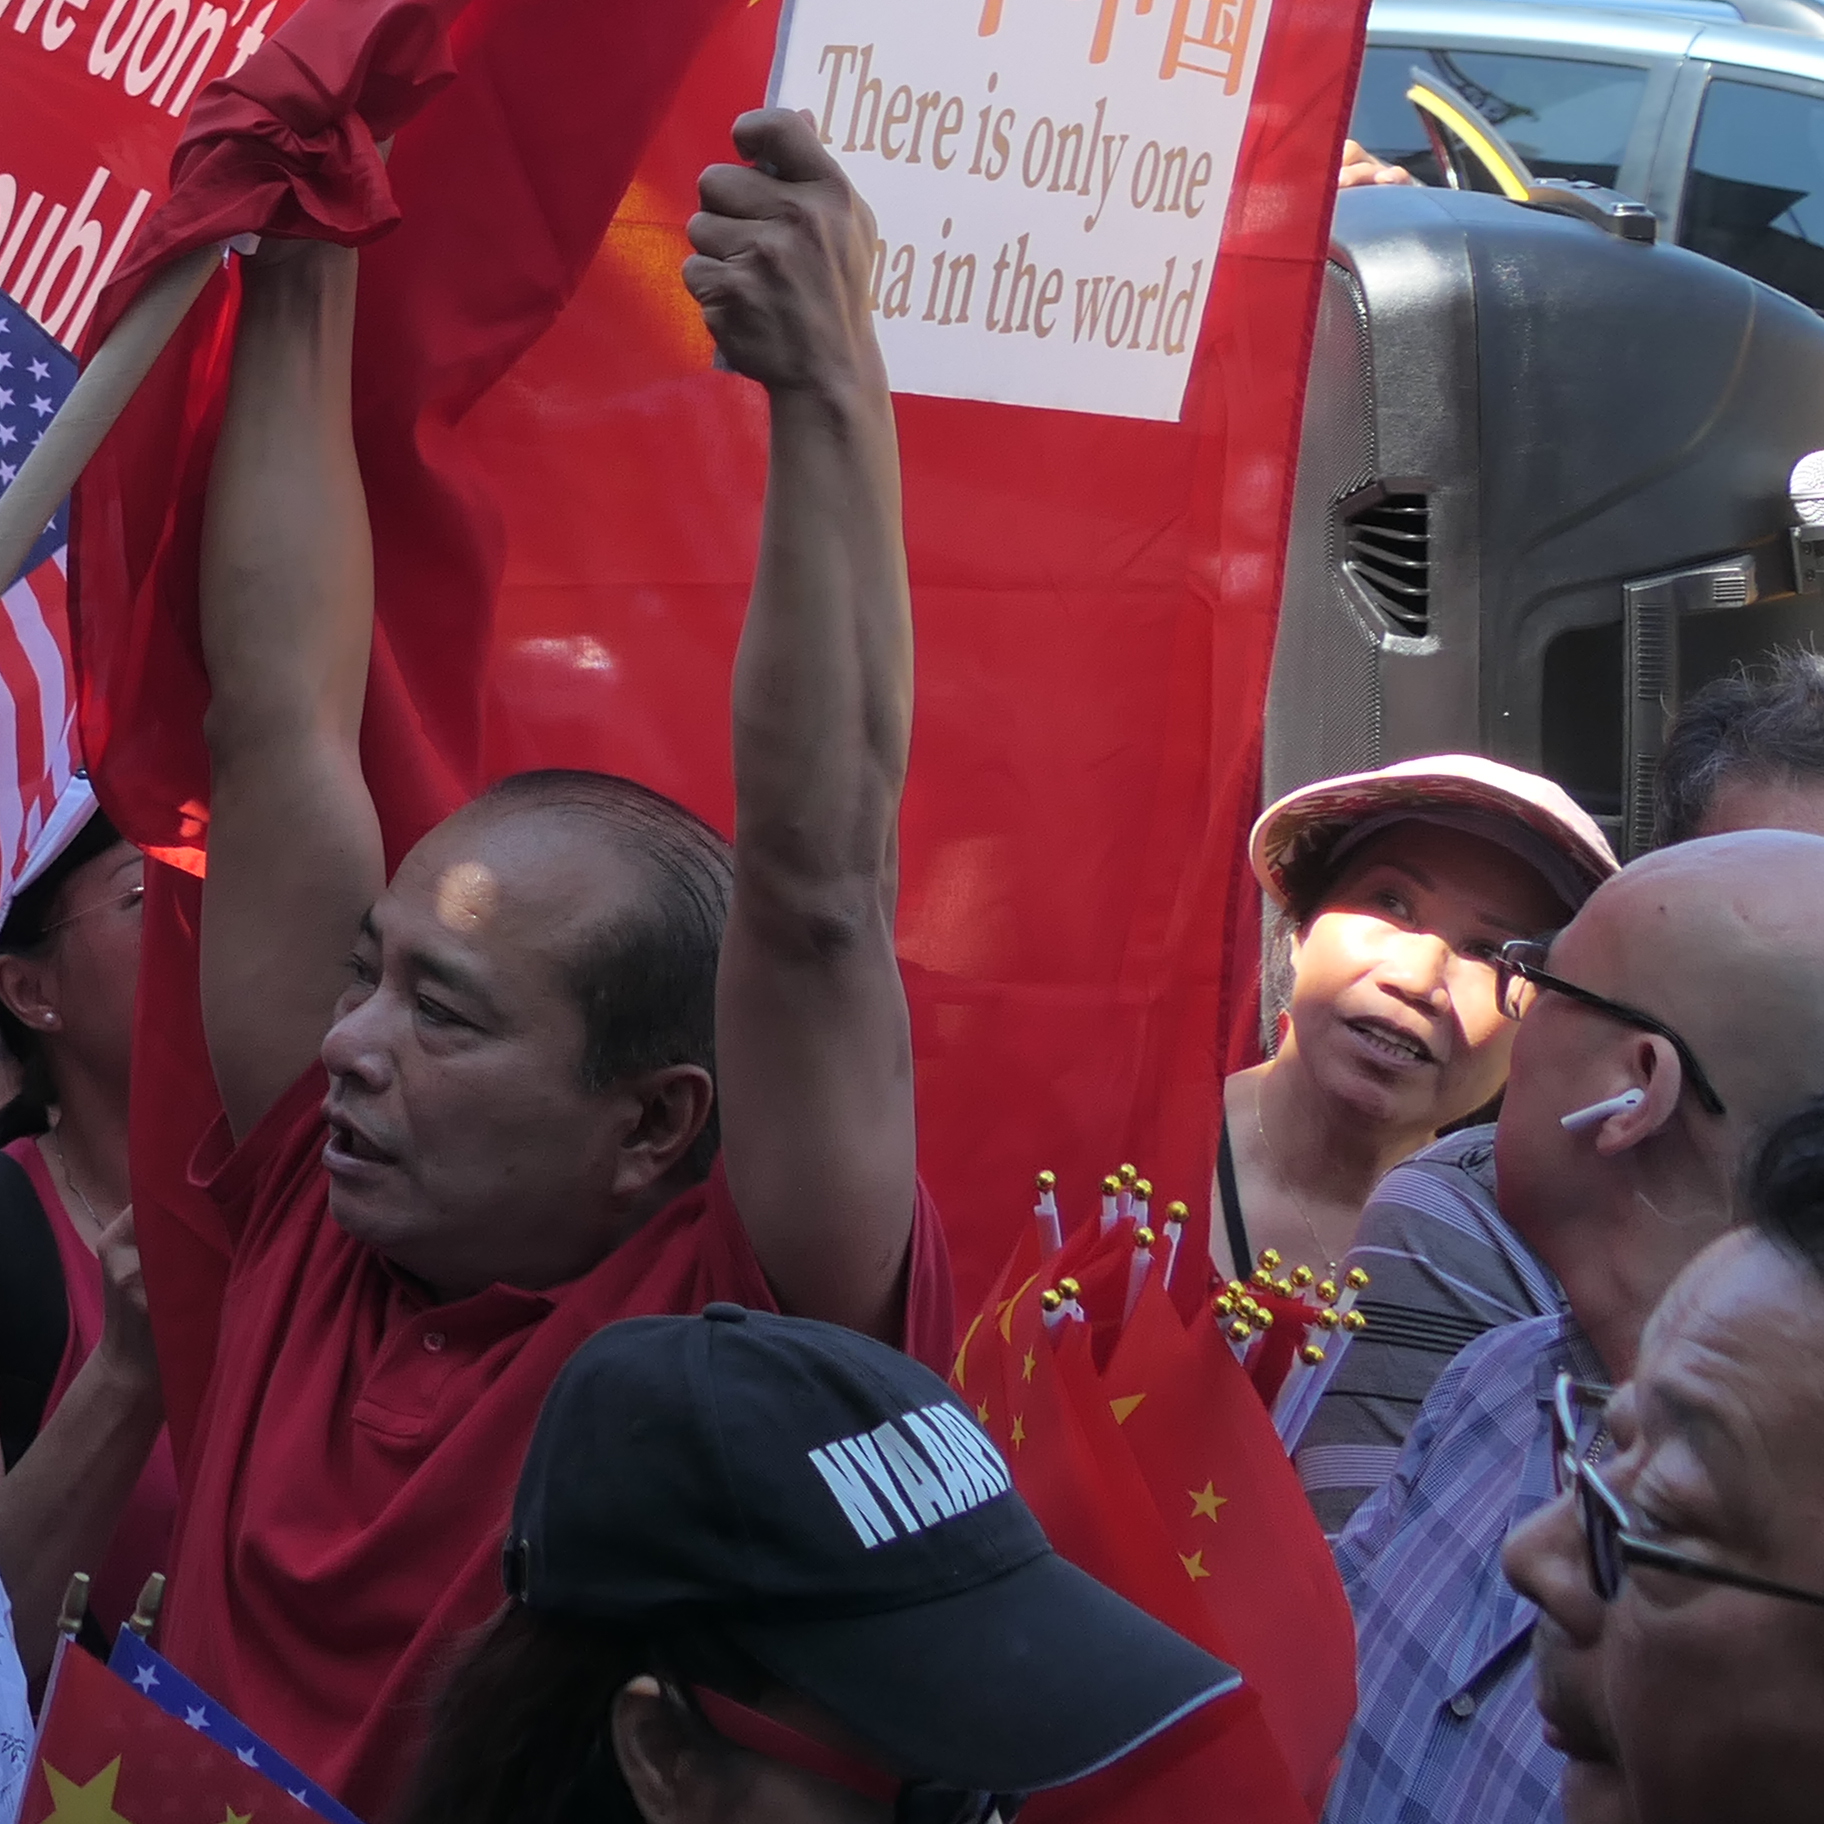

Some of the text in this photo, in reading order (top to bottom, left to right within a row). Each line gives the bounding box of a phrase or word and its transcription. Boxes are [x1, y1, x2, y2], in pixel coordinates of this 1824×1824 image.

[817, 42, 1213, 234] There is only one
[922, 217, 978, 326] in
[984, 232, 1065, 339] the
[1072, 255, 1205, 357] world
